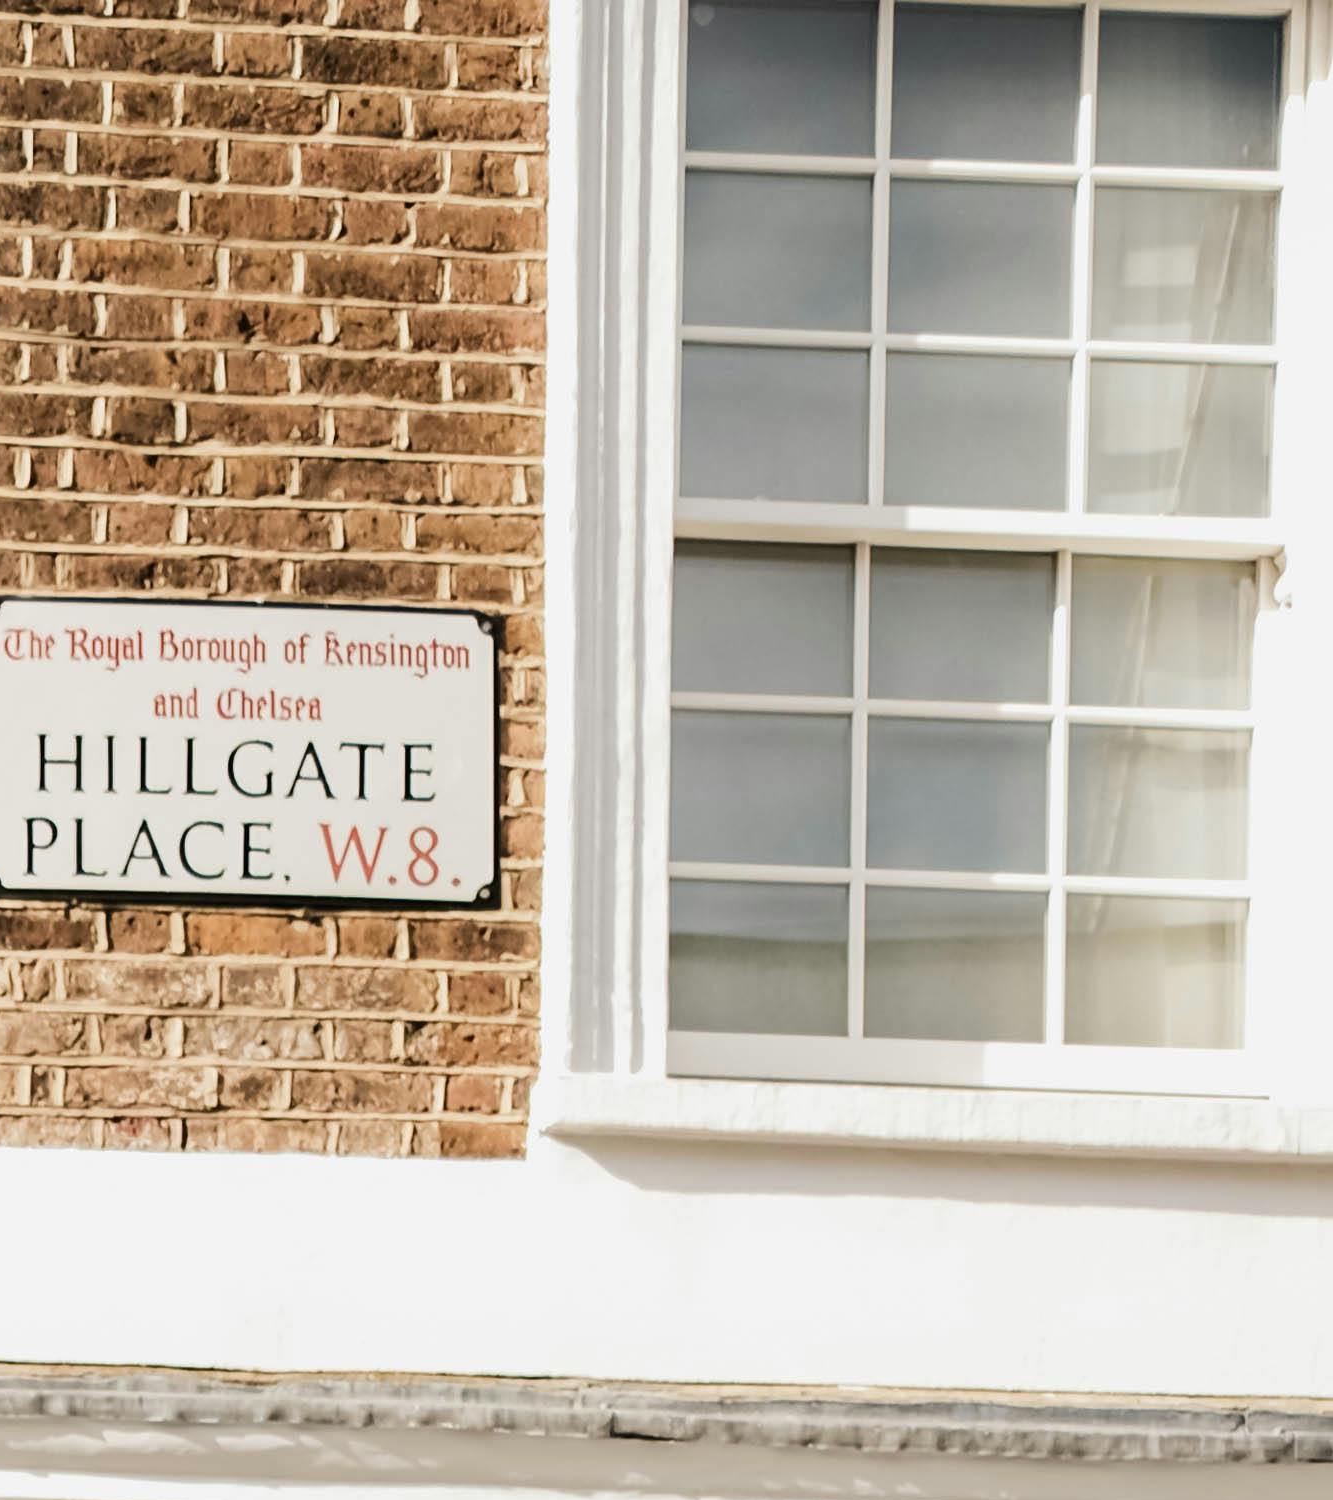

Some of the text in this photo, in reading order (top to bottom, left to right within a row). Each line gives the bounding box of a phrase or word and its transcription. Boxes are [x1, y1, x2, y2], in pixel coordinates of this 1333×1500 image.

[4, 627, 471, 678] The Royal Borough of Kensington
[153, 688, 323, 722] and Chelsea
[37, 734, 437, 802] HILLGATE
[319, 823, 463, 888] W.8.
